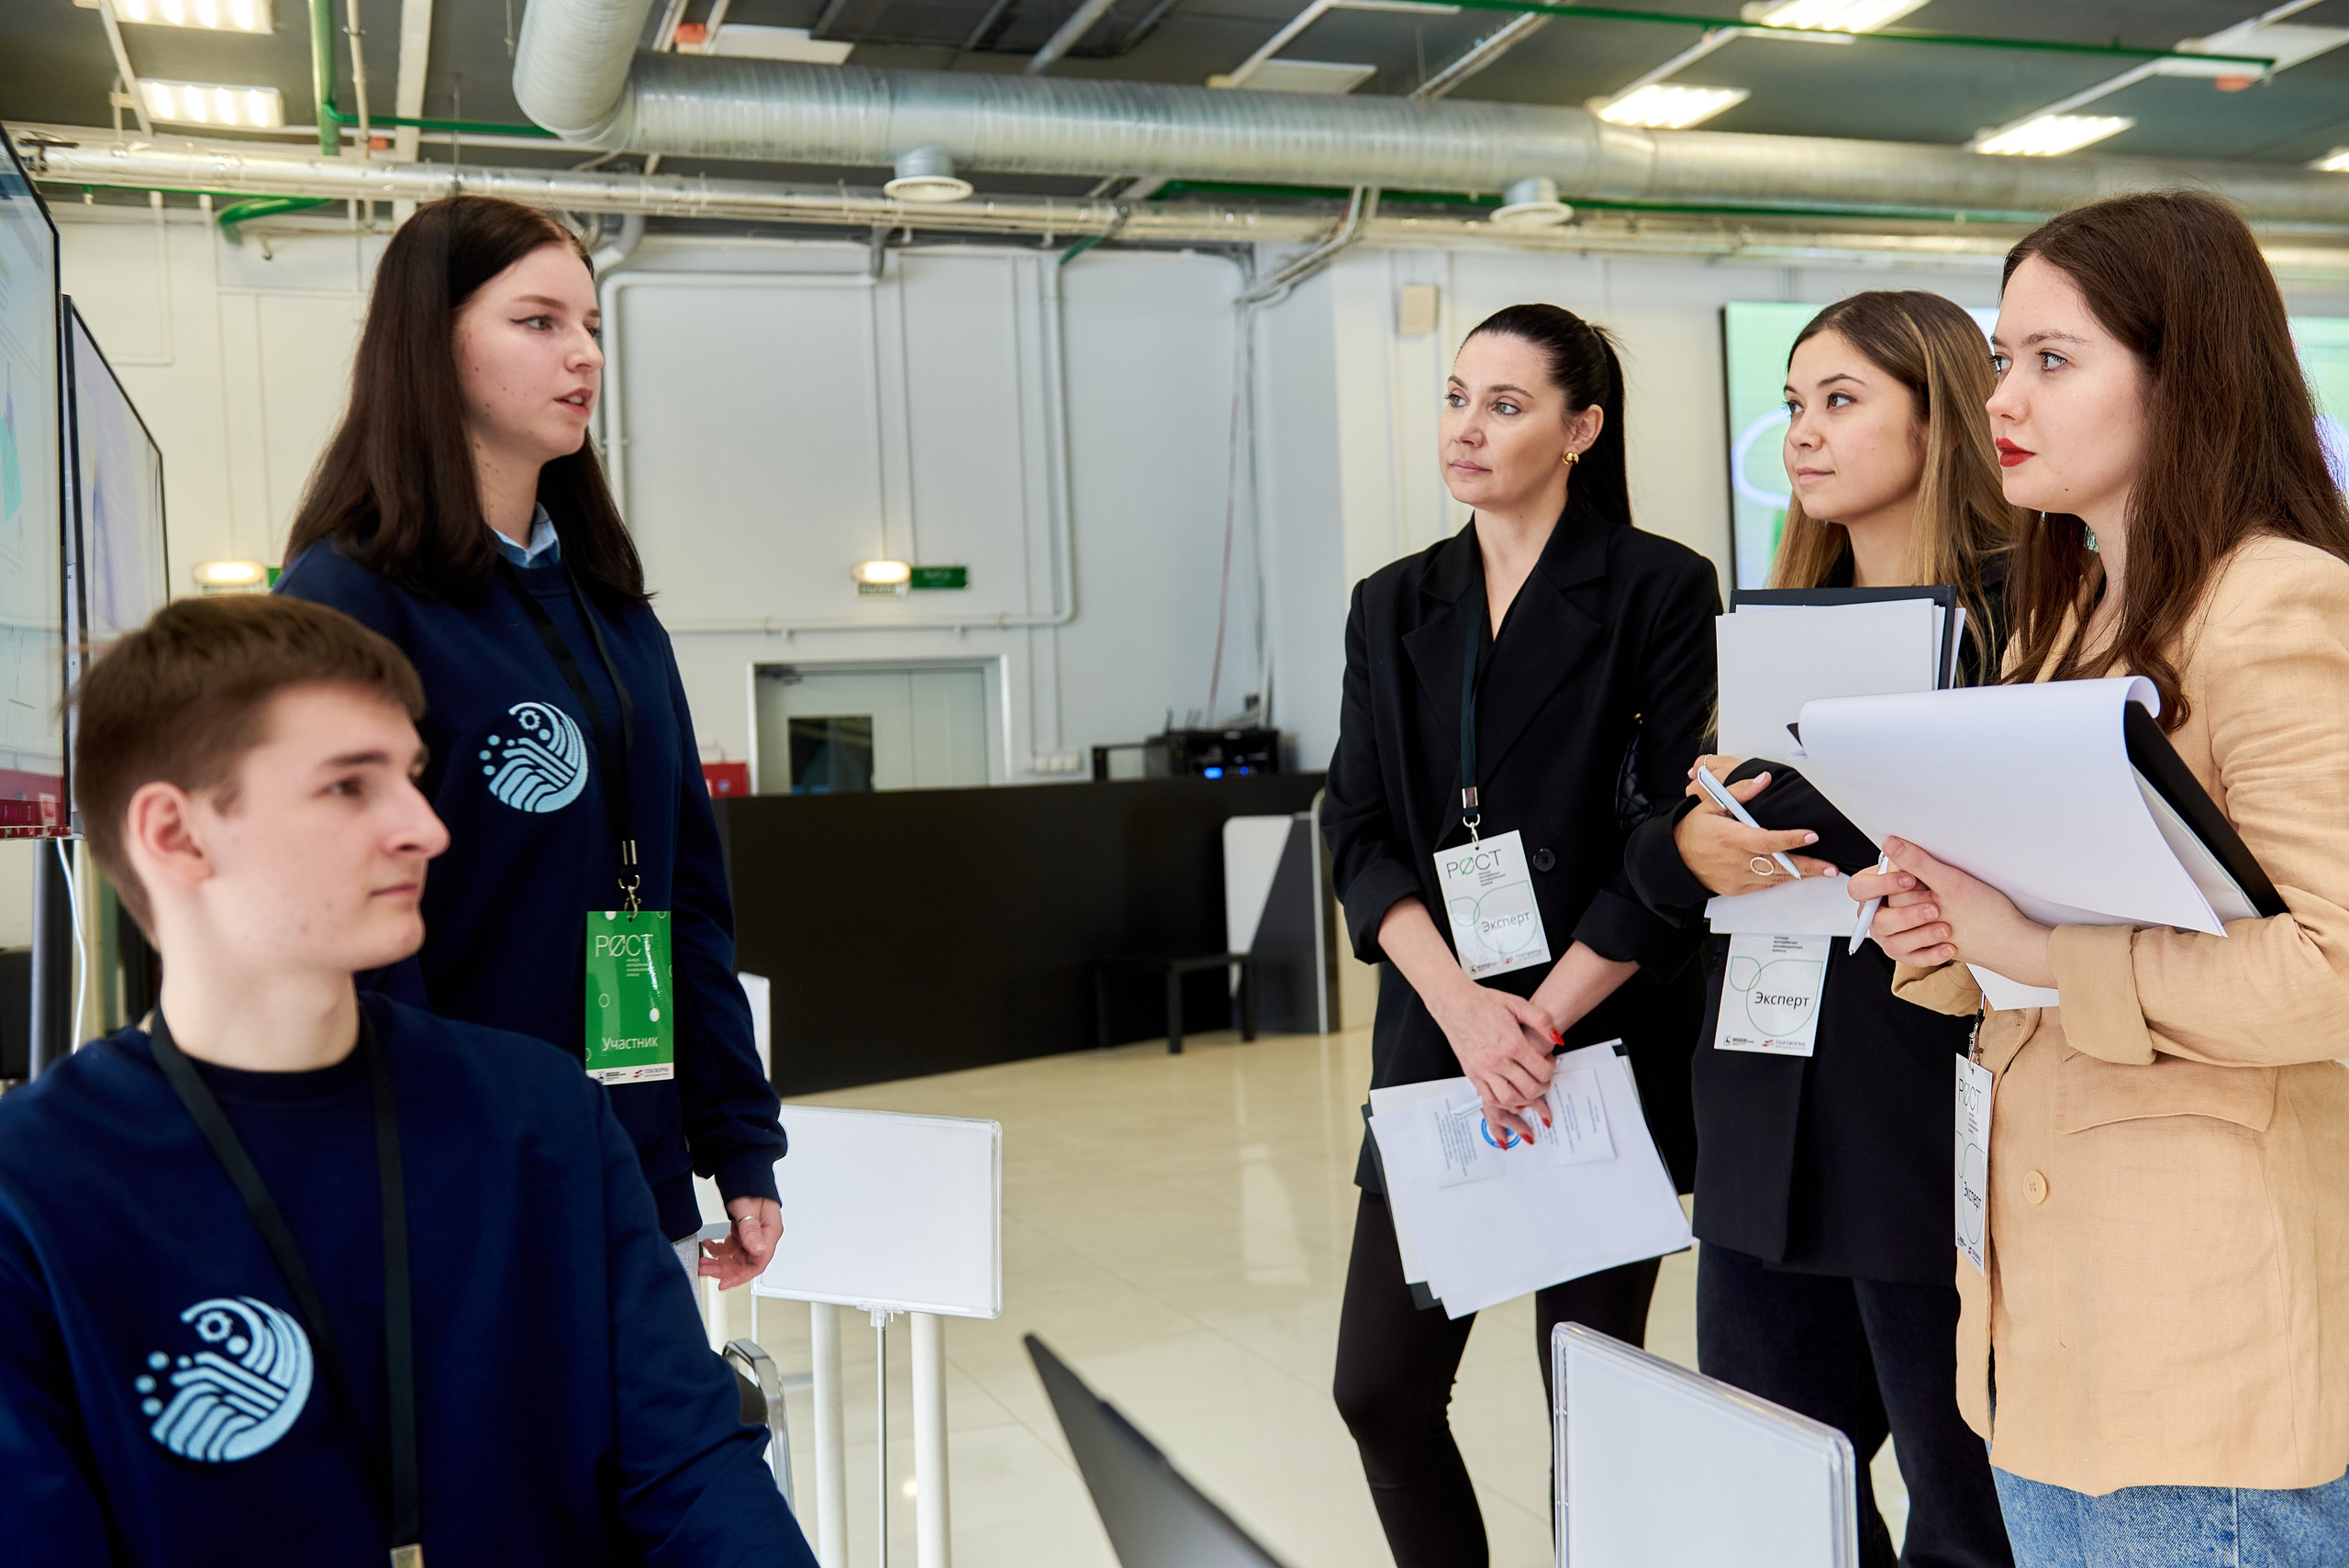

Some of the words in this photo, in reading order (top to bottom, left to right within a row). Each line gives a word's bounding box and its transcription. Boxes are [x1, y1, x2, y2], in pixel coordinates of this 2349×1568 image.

[1482, 912, 1531, 932] Эксперт
[1754, 992, 1809, 1009] Эксперт
[602, 1037, 659, 1051] Участник
[1964, 1181, 1982, 1212] Эксперт
